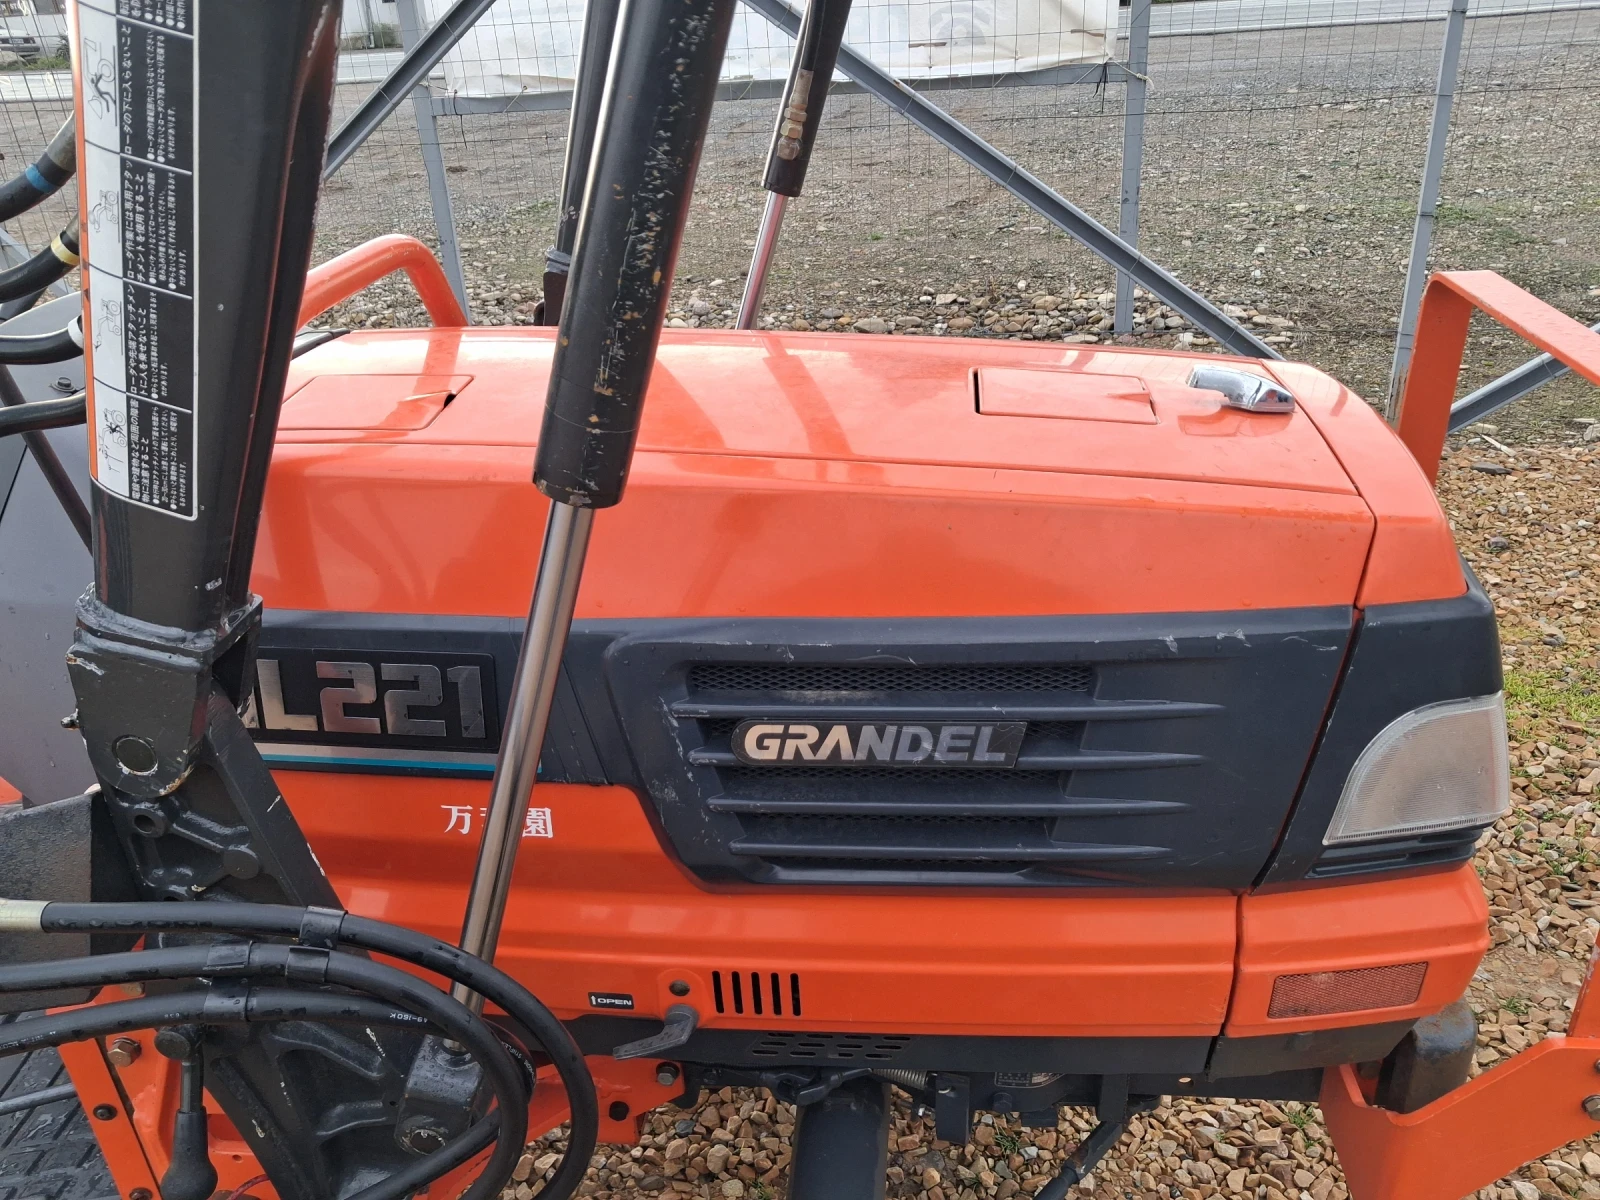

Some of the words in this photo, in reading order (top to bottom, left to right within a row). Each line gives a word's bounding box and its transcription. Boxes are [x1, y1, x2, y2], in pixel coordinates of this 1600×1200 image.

[122, 25, 133, 155] ローダの下に入らないこと
[124, 160, 135, 279] ローダ作業には専用アタッ
[135, 173, 146, 282] チメントを使用すること
[127, 284, 138, 394] ローダや先端アタッチメン
[138, 307, 149, 396] トに人を乗せないこと
[130, 399, 141, 500] 電線や建物など周囲の障害
[140, 436, 151, 503] 物に注意すること
[242, 659, 486, 739] L221
[744, 724, 1006, 760] GRANDEL
[441, 804, 554, 839] 万園
[597, 997, 632, 1006] OPEN
